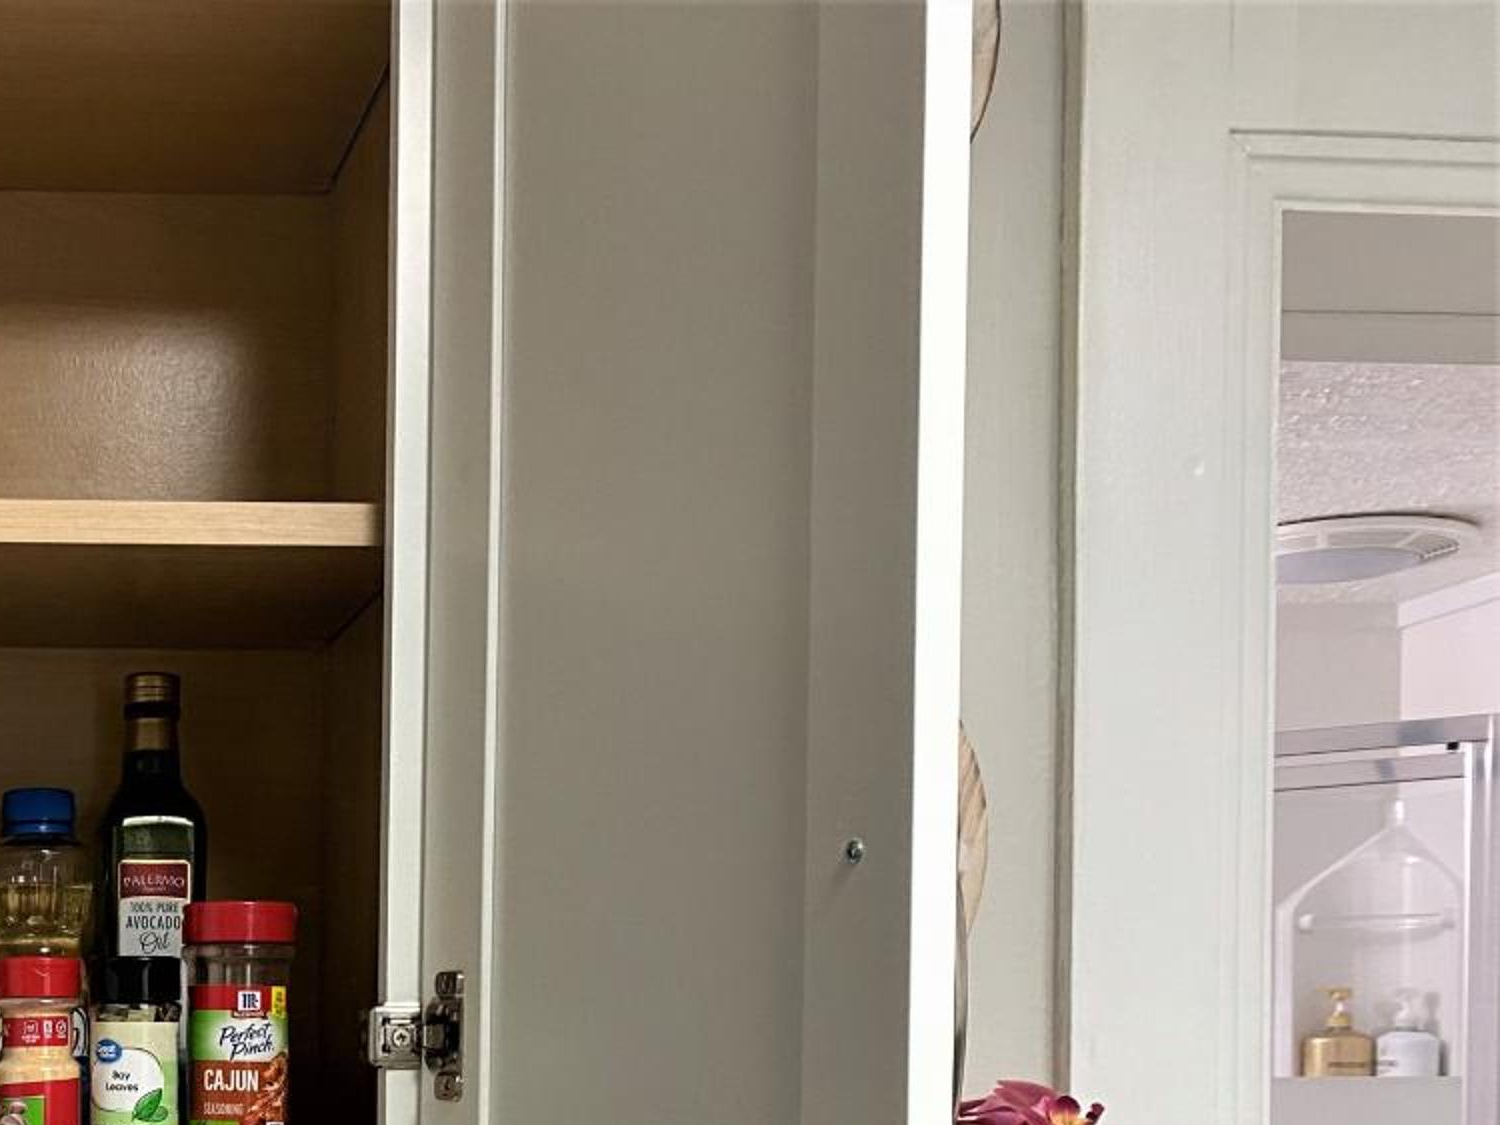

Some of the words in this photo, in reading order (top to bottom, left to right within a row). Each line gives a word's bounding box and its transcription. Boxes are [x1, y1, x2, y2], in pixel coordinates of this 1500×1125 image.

[123, 875, 186, 889] PALERMO
[125, 915, 181, 931] AVOCADO
[219, 1023, 273, 1048] Perfect
[230, 1033, 273, 1061] Pinch
[112, 1070, 131, 1082] Bay
[203, 1068, 260, 1093] CAJUN
[105, 1081, 139, 1092] Leaves
